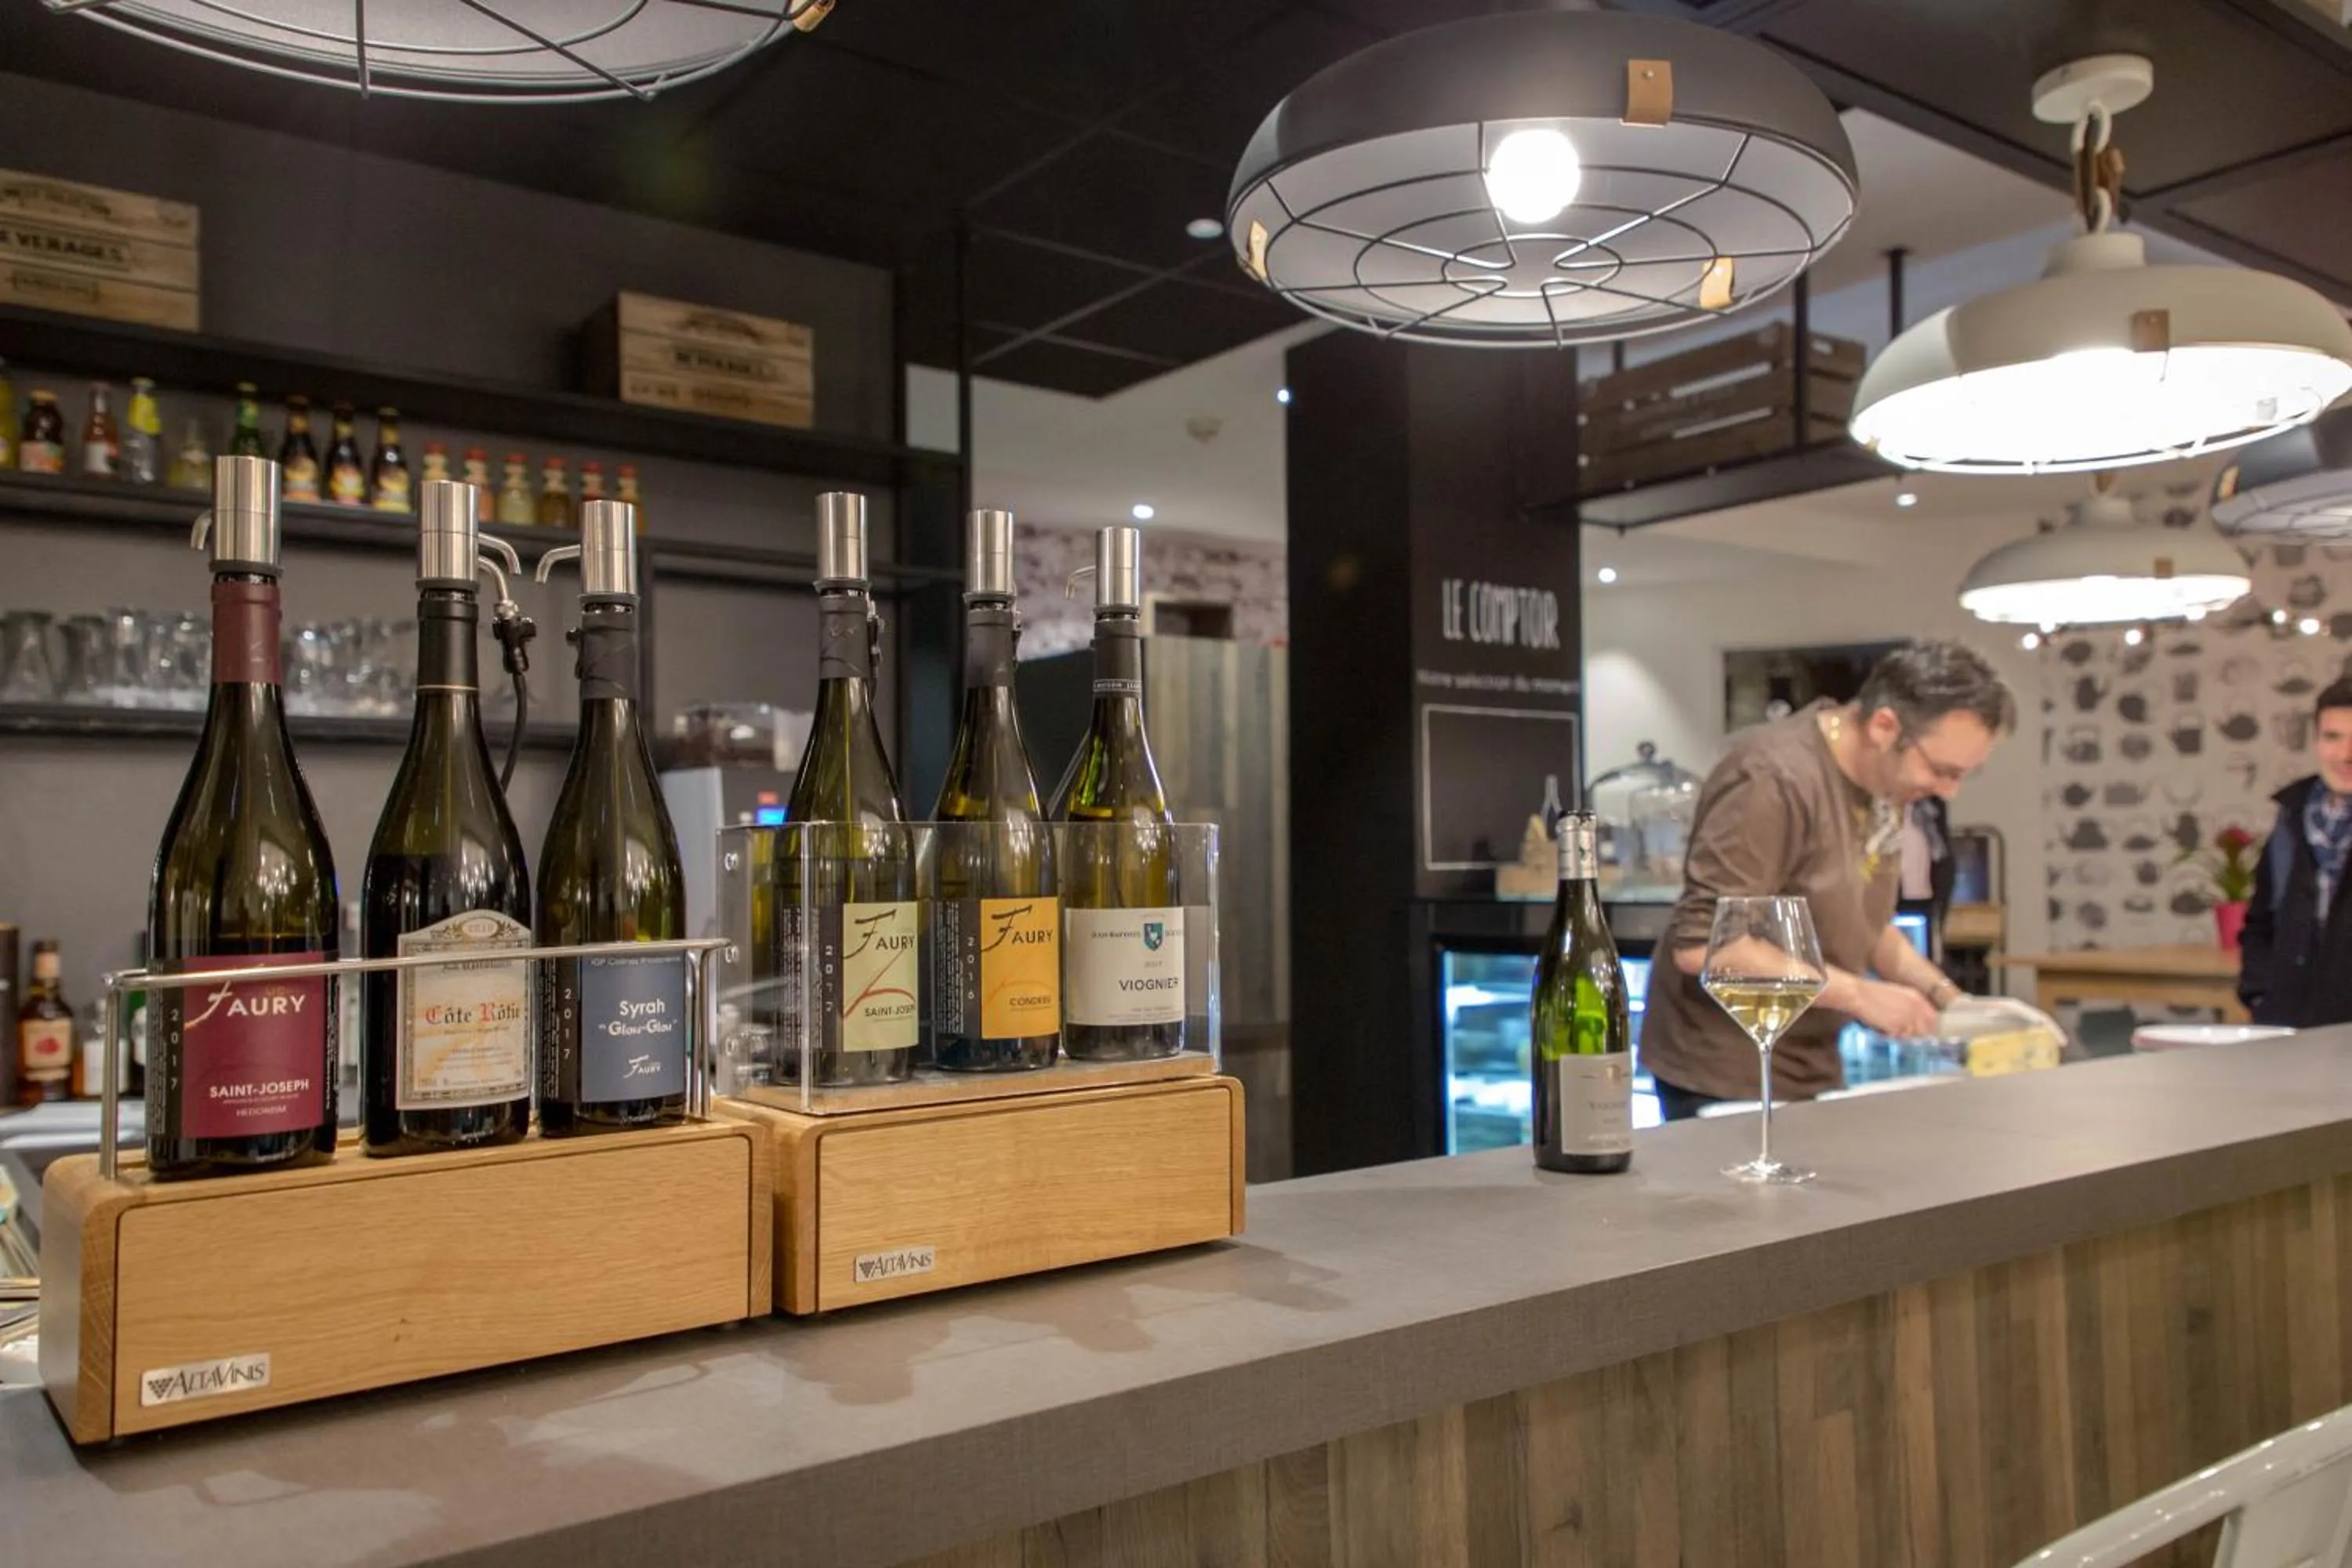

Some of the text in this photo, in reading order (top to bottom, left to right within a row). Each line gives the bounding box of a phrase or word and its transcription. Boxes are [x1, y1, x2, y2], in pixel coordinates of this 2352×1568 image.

[1443, 578, 1464, 641] LE
[843, 909, 916, 960] FAURY
[982, 905, 1054, 952] FAURY
[1119, 978, 1178, 991] VIOGNIER
[184, 981, 306, 1029] FAURY
[426, 1006, 472, 1025] Côte
[619, 998, 666, 1019] Syrah
[209, 1078, 310, 1098] SAINT-JOSEPH
